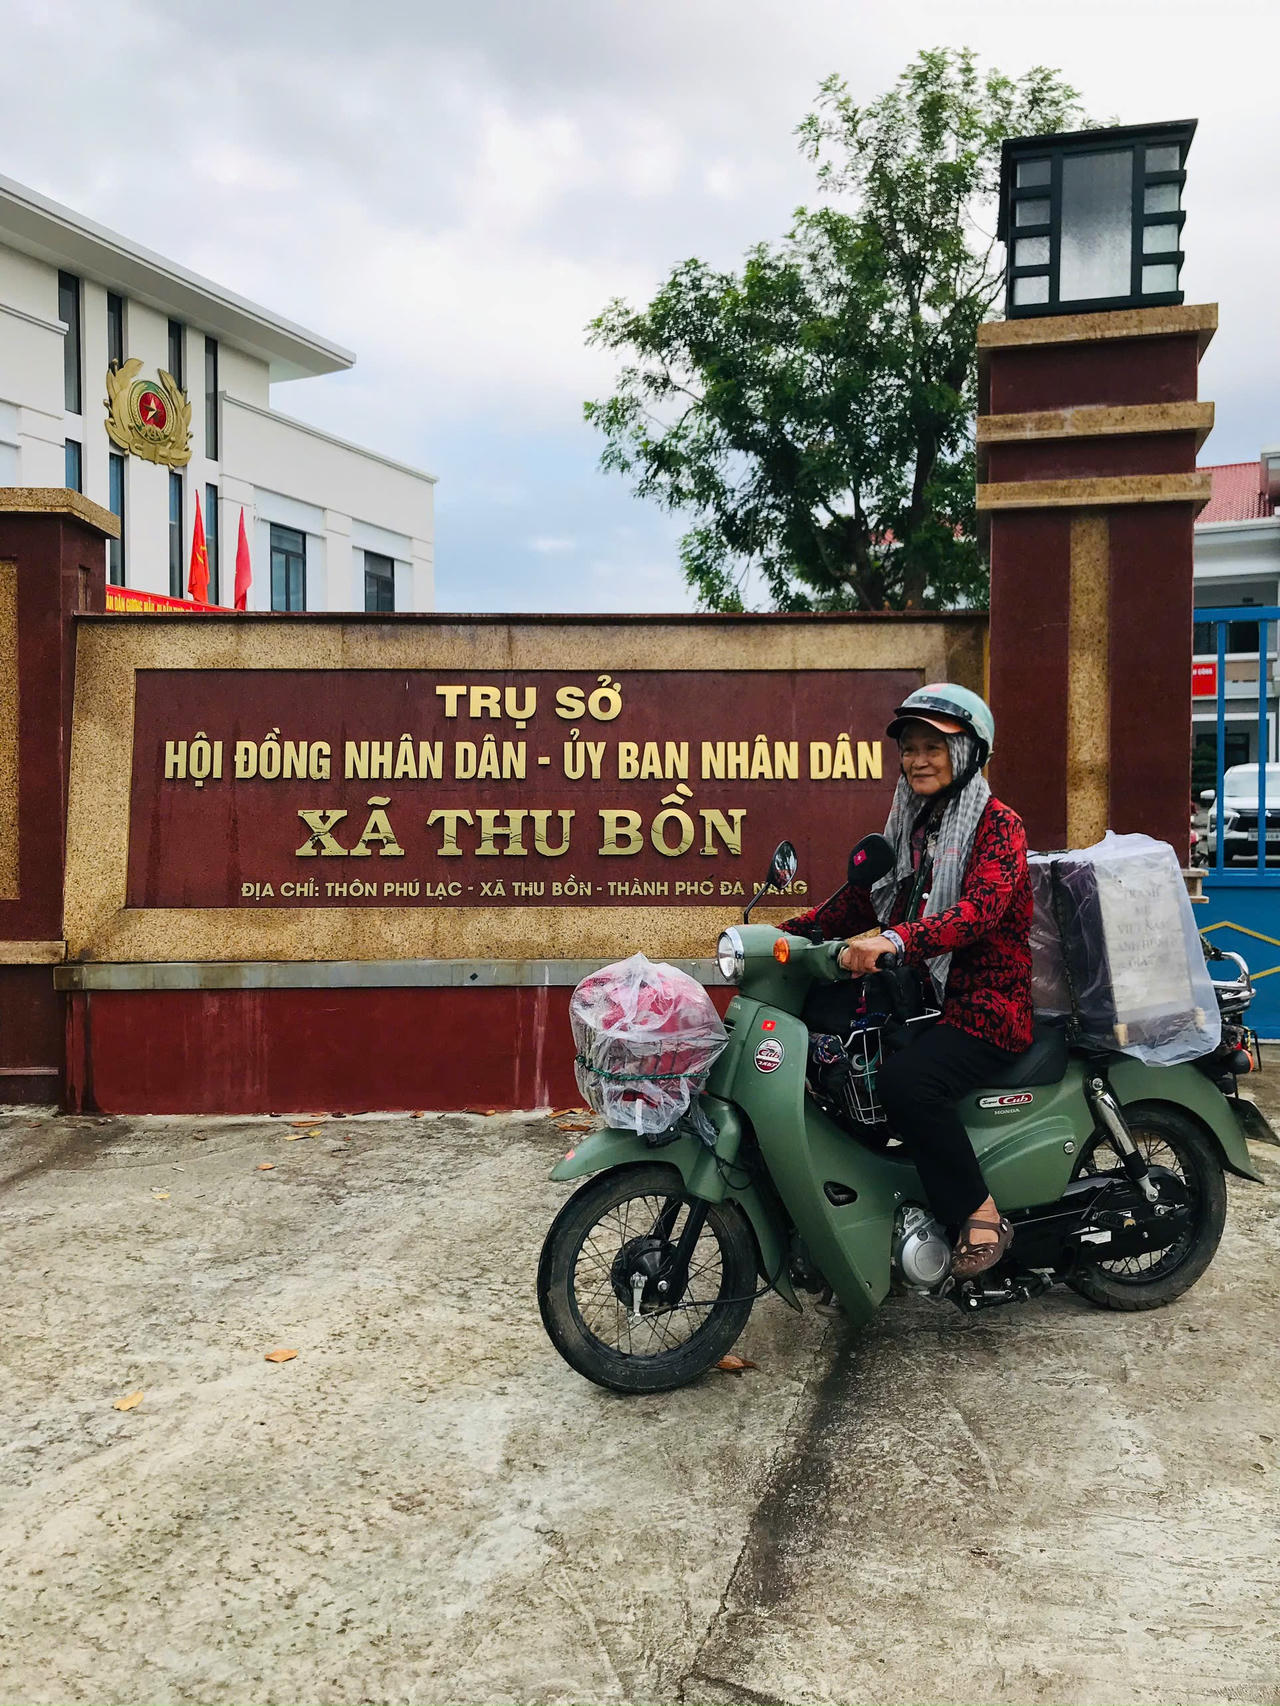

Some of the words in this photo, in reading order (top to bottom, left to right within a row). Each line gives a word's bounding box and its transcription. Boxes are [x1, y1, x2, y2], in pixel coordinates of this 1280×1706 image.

[435, 685, 537, 729] TRỤ
[555, 674, 623, 721] SỞ
[164, 731, 223, 787] HỘI
[234, 727, 331, 780] ĐỒNG
[344, 733, 443, 780] NHÂN
[454, 733, 527, 780] DÂN
[563, 727, 607, 780] ỦY
[618, 741, 689, 780] BAN
[701, 733, 799, 780] NHÂN
[809, 732, 882, 780] DÂN
[295, 795, 405, 857] XÃ
[426, 809, 576, 857] THU
[598, 782, 747, 857] BỒN
[241, 881, 275, 900] ĐỊA
[280, 877, 319, 897] CHỈ:
[325, 878, 378, 897] THÔN
[383, 878, 420, 897] PHÚ
[426, 881, 463, 900] LẠC
[480, 878, 506, 897] XÃ
[511, 881, 545, 896] THU
[552, 874, 592, 896] BỒN
[607, 877, 669, 896] THÀNH
[1002, 1095, 1029, 1105] Cub
